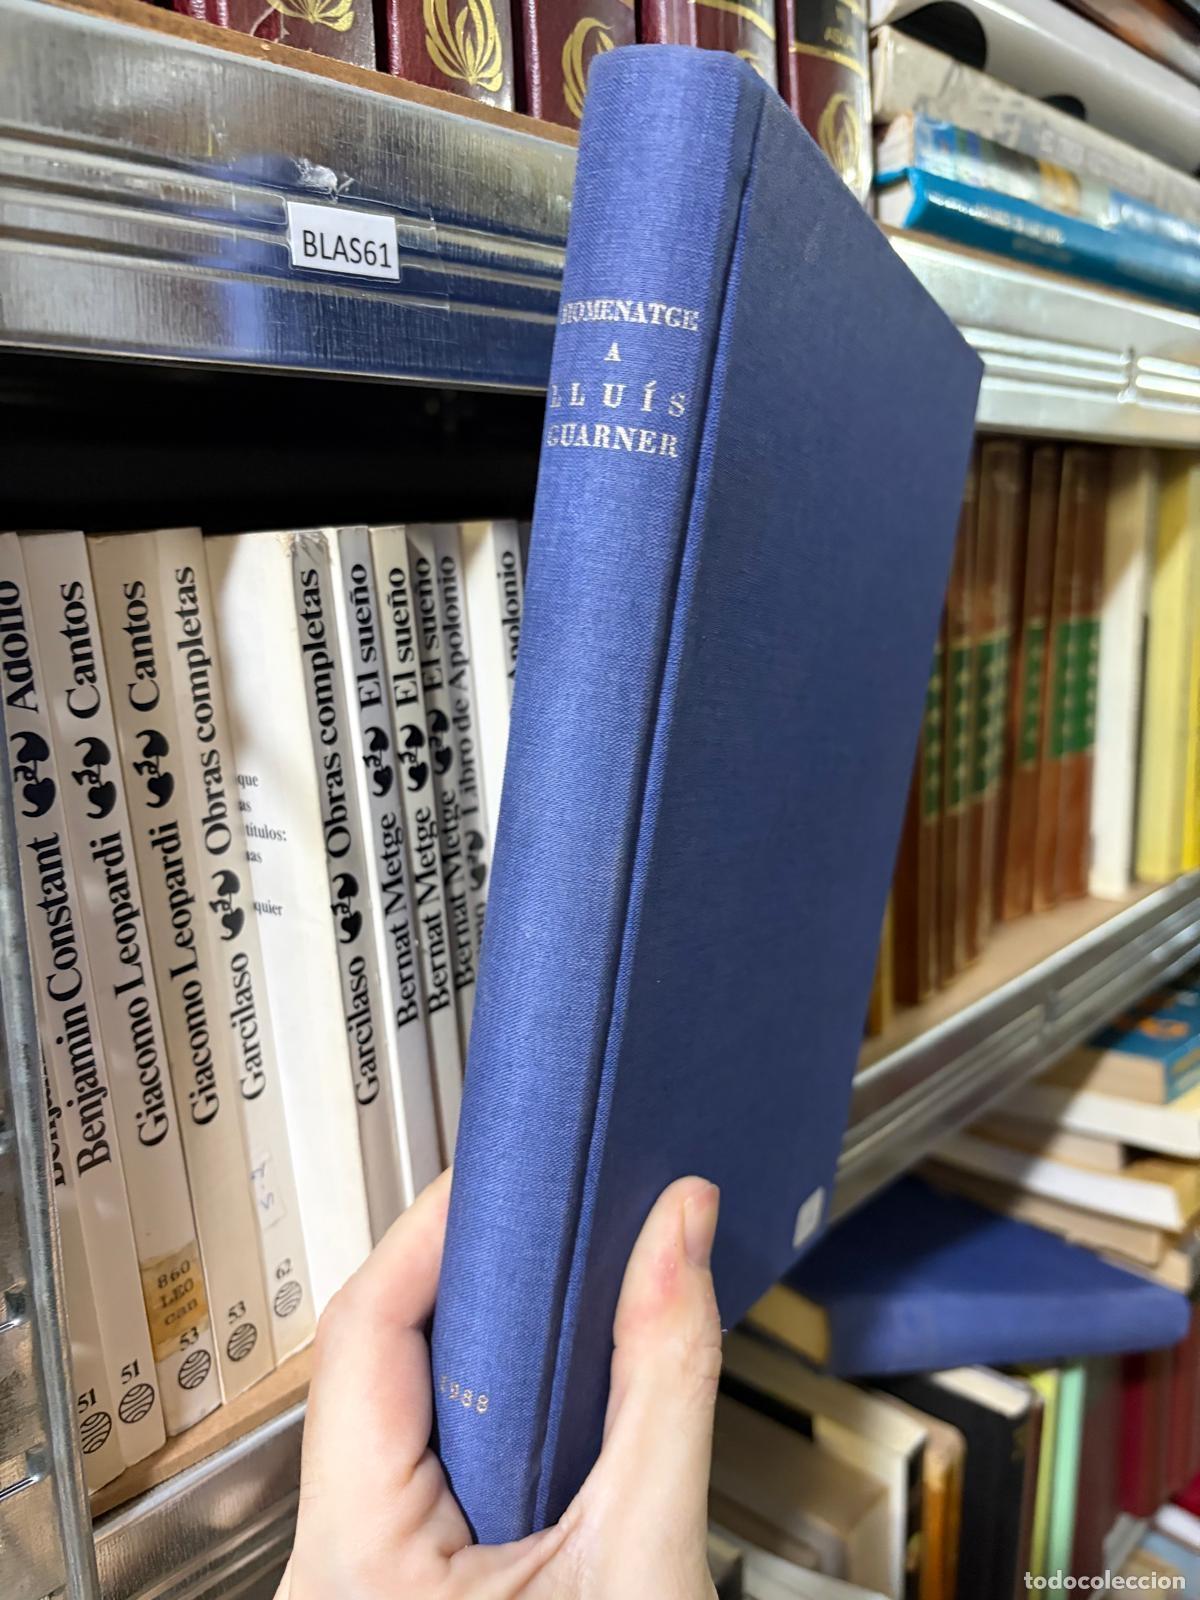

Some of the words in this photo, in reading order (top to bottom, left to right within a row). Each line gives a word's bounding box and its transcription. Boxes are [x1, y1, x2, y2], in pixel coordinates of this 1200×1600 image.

[303, 229, 392, 269] BLAS61
[560, 299, 699, 331] HOMENATGE
[603, 342, 621, 361] A
[60, 580, 101, 719] Cantos
[123, 580, 160, 712] Cantos
[175, 566, 217, 743] completas
[299, 568, 338, 746] completas
[349, 563, 377, 664] sueño
[387, 567, 415, 664] sueño
[437, 556, 470, 690] Apolonio
[357, 669, 383, 710] El
[394, 669, 420, 708] El
[421, 658, 443, 691] El
[452, 699, 471, 731] de
[201, 749, 232, 856] Obras
[324, 751, 351, 858] Obras
[148, 820, 197, 981] Leopardi
[380, 811, 407, 918] Metge
[414, 806, 439, 907] Metge
[26, 831, 82, 1001] Constant
[90, 830, 146, 999] Leopardi
[422, 912, 451, 1016] Bernat
[451, 891, 475, 990] Bernat
[390, 919, 419, 1029] Bernat
[128, 996, 169, 1147] Giacomo
[181, 979, 220, 1126] Giacomo
[229, 952, 266, 1101] Garcilaso
[348, 955, 380, 1106] Garcilaso
[56, 1002, 112, 1178] Benjamin
[157, 1260, 190, 1288] 860
[228, 1300, 247, 1324] 53
[276, 1258, 292, 1280] 62
[120, 1359, 140, 1385] 51
[179, 1326, 199, 1351] 53
[77, 1388, 97, 1415] 51
